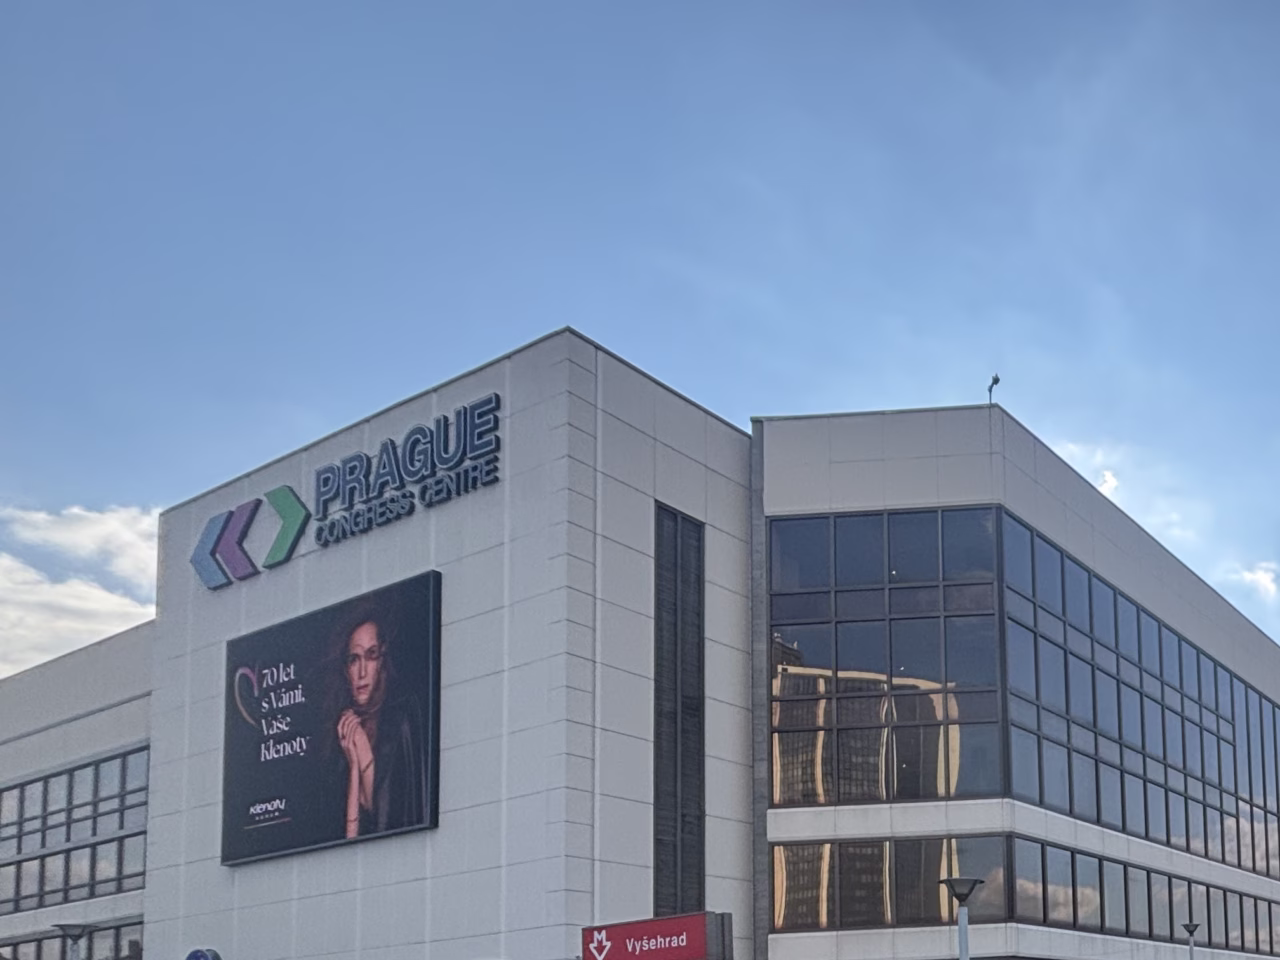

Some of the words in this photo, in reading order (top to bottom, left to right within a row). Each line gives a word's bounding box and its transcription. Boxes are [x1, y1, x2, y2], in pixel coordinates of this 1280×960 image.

[313, 391, 501, 522] PRAGUE
[314, 489, 415, 548] CONGRESS
[418, 454, 500, 507] CENTRE
[261, 666, 278, 688] 70
[279, 662, 296, 683] let
[261, 714, 291, 736] Vaše
[626, 931, 688, 955] Vyšehrad
